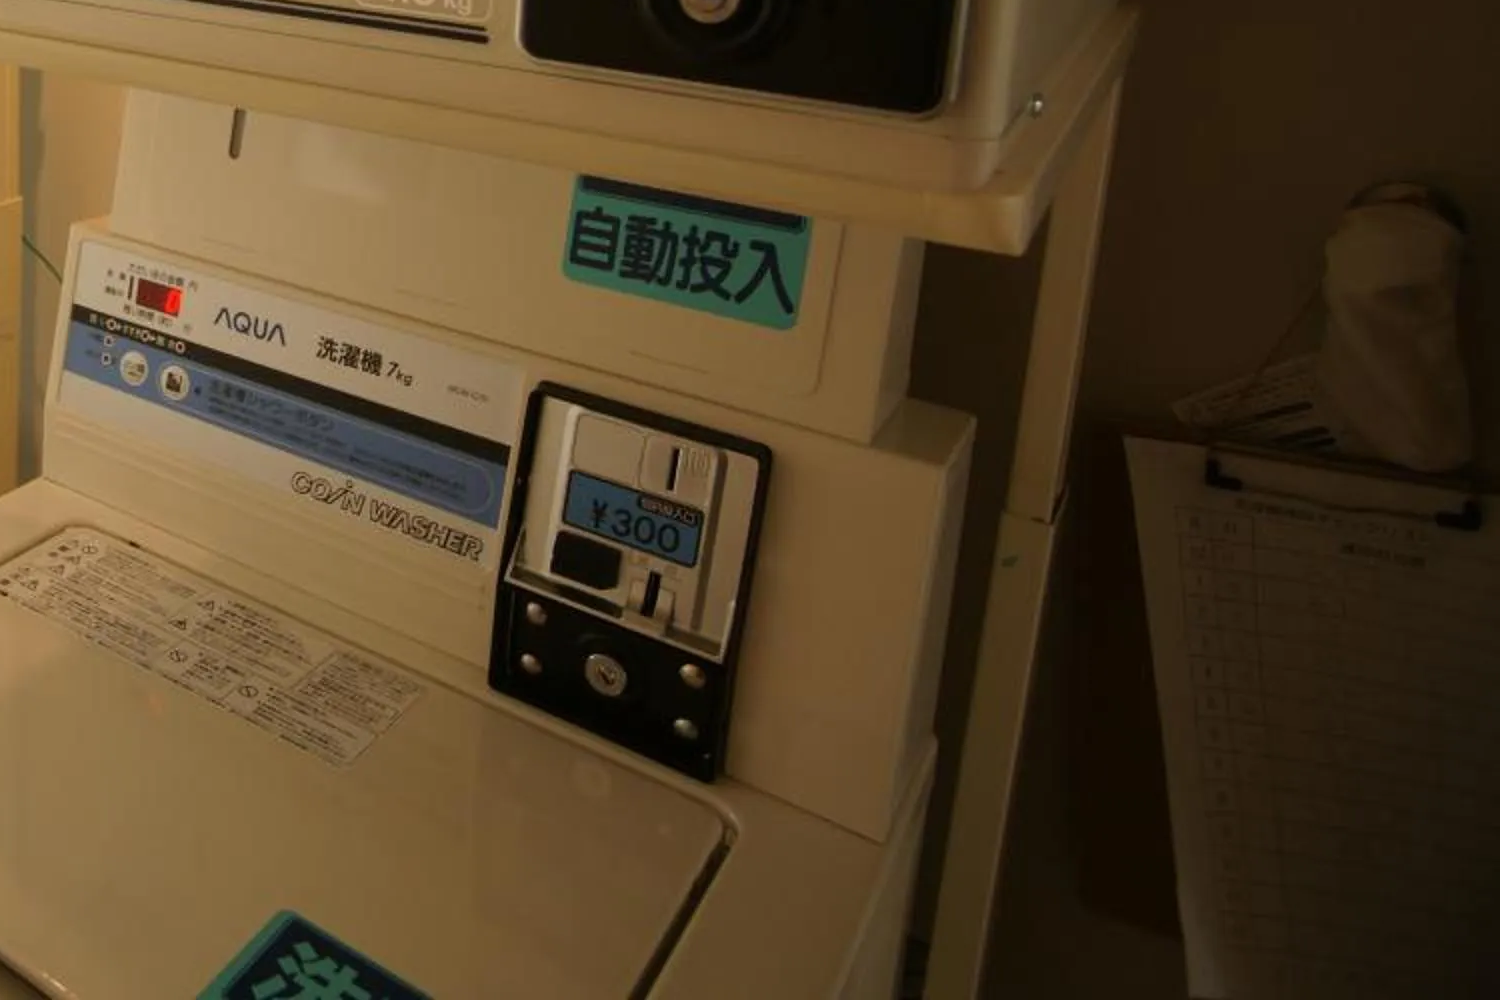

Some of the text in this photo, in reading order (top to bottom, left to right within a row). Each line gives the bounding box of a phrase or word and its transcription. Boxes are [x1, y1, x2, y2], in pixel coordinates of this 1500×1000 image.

[568, 206, 795, 315] 自動投入
[213, 307, 288, 348] AQUA
[316, 335, 383, 377] 洗濯機
[370, 498, 486, 562] WASHER
[591, 498, 680, 555] ¥300
[251, 941, 390, 1000] 洗
